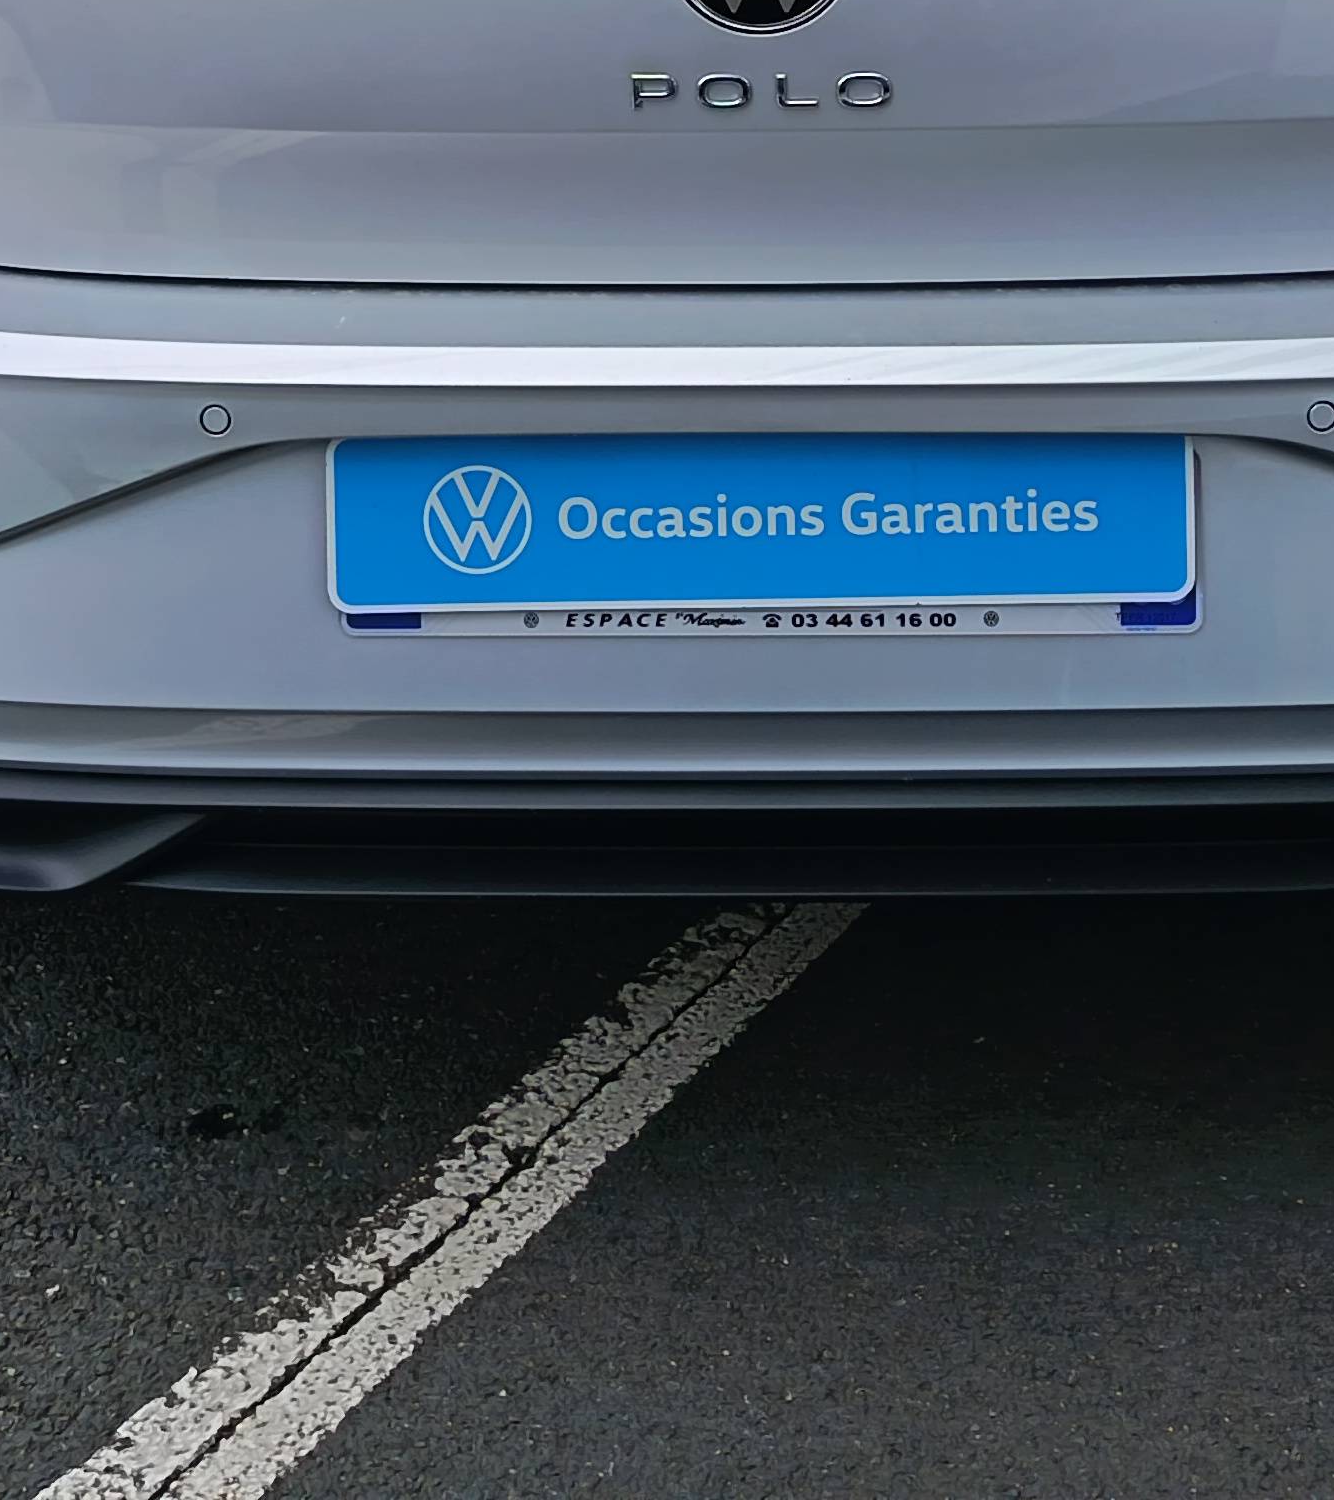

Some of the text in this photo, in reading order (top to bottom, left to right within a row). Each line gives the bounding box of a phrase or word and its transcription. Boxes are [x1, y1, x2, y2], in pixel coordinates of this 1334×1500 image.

[630, 71, 892, 110] POLO
[423, 465, 1099, 574] VW Occasions Garanties
[565, 612, 668, 628] ESPACE
[791, 613, 818, 628] 03
[825, 613, 853, 628] 44
[860, 613, 886, 628] 61
[895, 613, 922, 628] 16
[929, 612, 957, 628] 00
